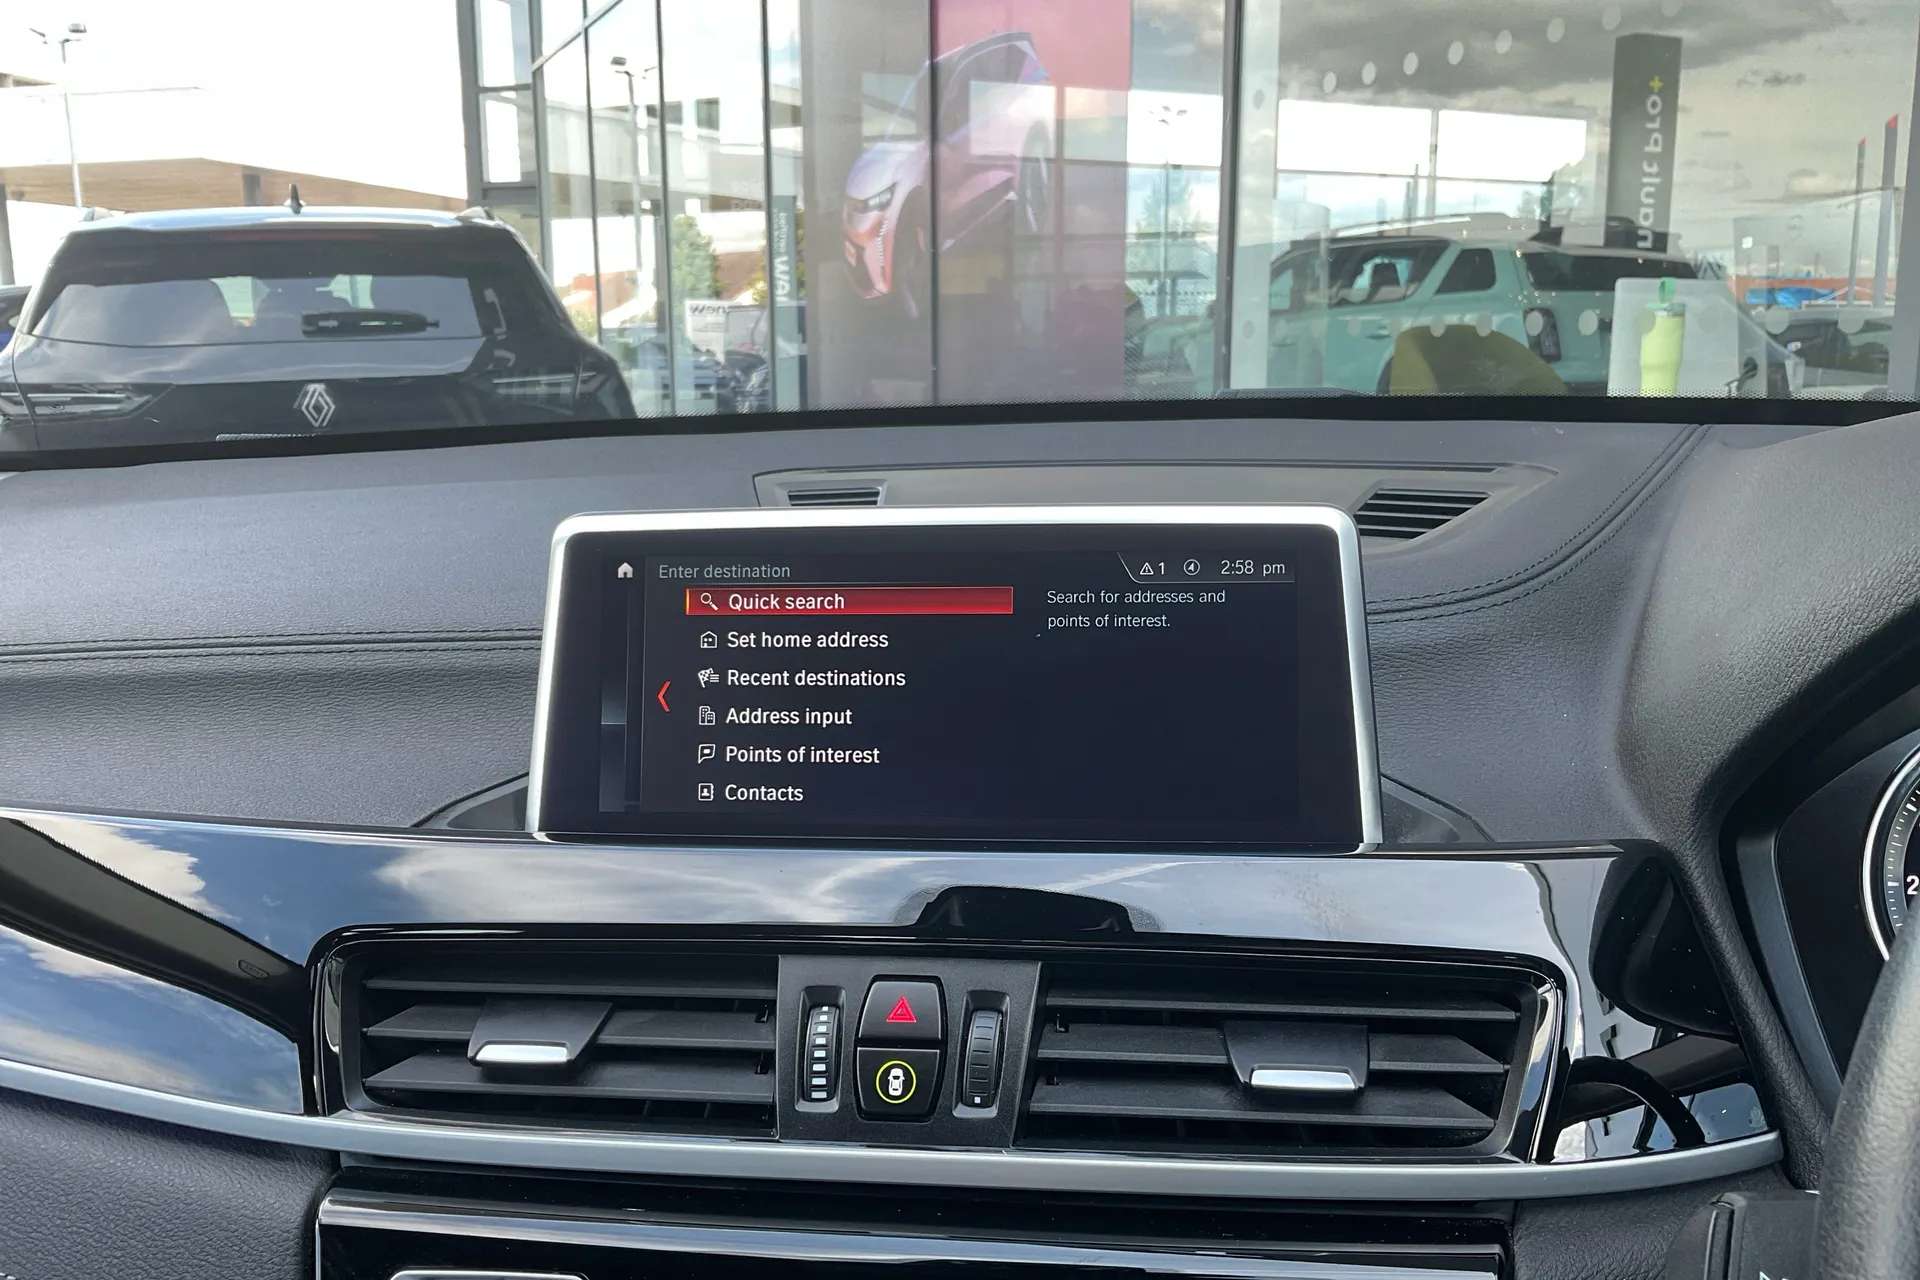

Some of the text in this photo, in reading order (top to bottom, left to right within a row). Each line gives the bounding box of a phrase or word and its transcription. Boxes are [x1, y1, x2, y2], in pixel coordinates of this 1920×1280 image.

[658, 563, 791, 579] Enter destination
[1158, 561, 1166, 576] 1
[1220, 559, 1286, 578] 2:58 pm
[728, 592, 845, 611] Quick search
[1047, 589, 1226, 604] Search for addresses and
[1048, 613, 1171, 630] points of interest.
[727, 631, 889, 648] Set home address
[727, 668, 906, 687] Recent destinations
[725, 707, 853, 729] Address input
[725, 745, 880, 764] Points of interest
[725, 783, 804, 802] Contacts
